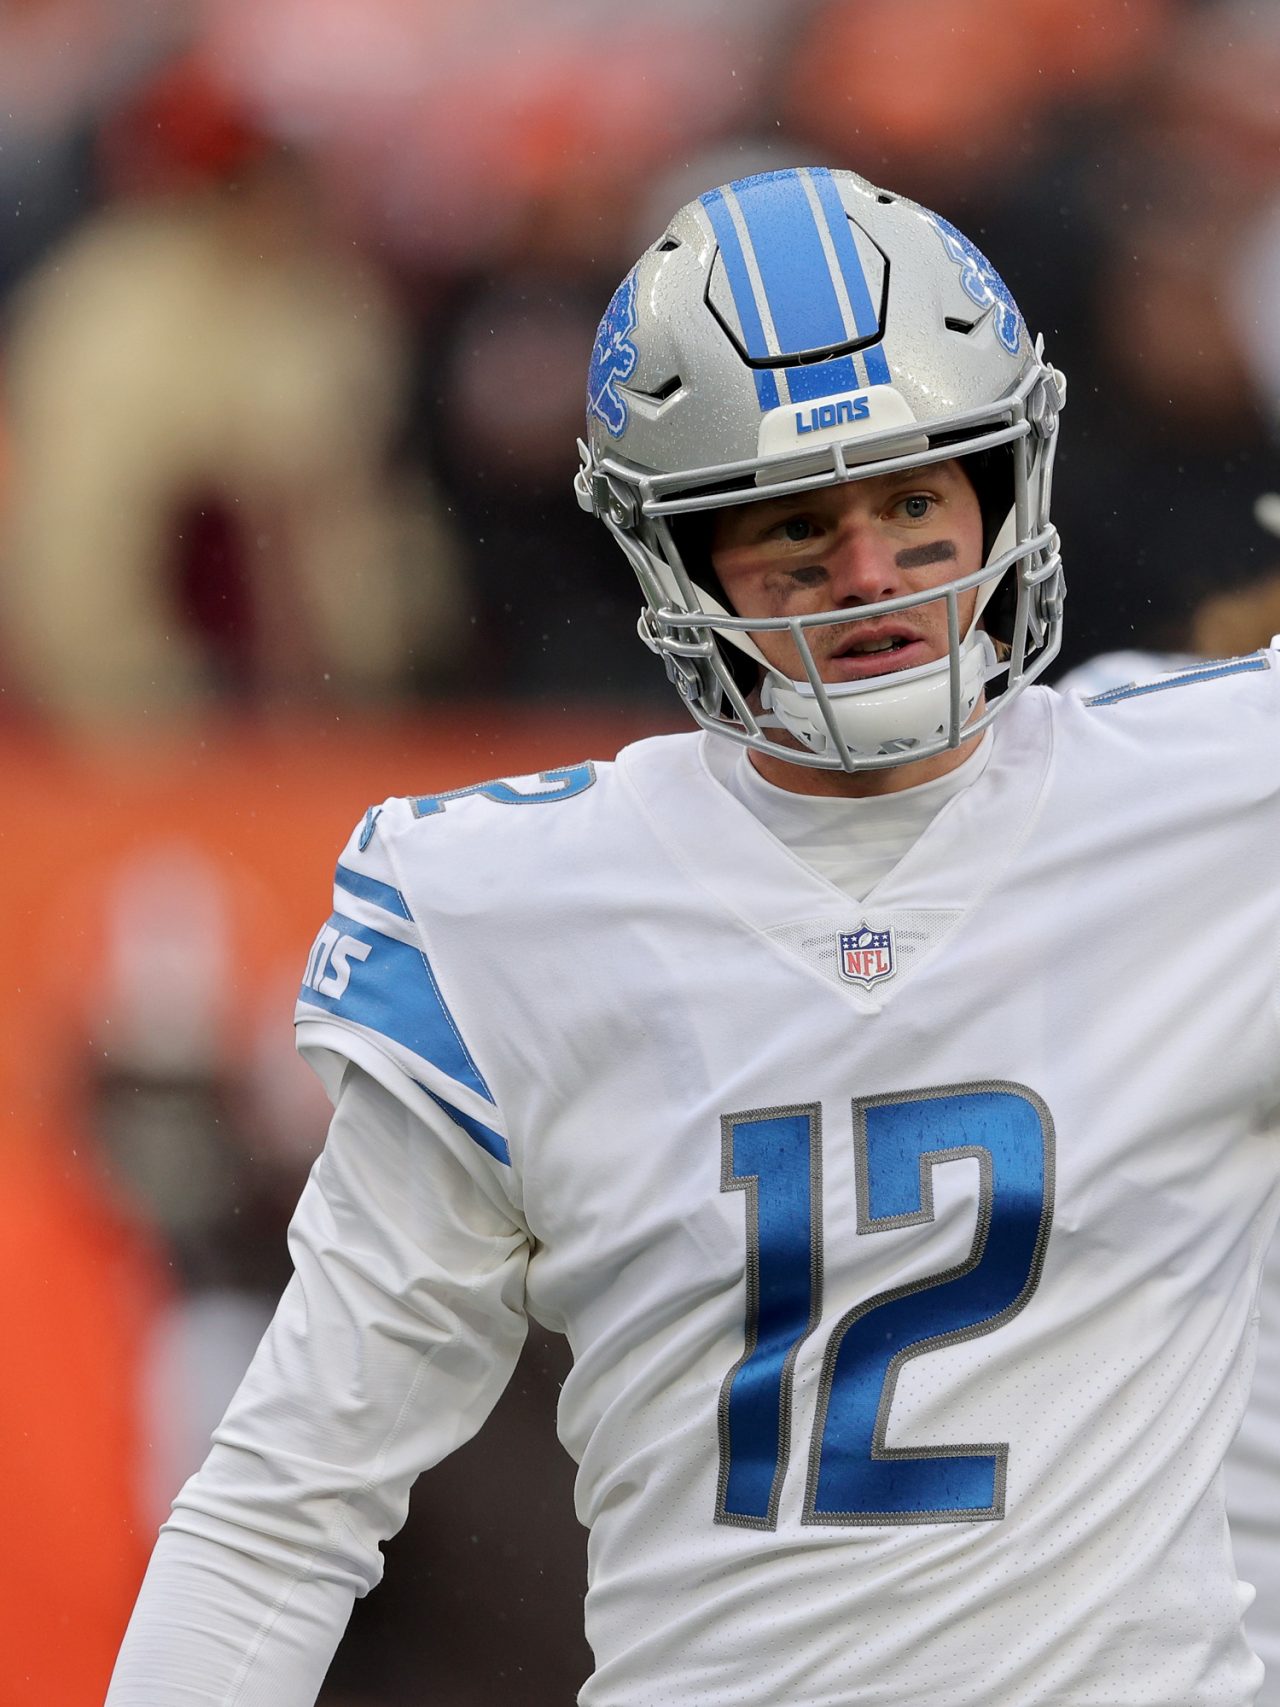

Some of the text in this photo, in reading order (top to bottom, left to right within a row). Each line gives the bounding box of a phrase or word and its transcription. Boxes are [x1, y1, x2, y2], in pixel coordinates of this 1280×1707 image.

[795, 396, 870, 434] LIONS
[846, 950, 888, 976] NFL
[713, 1079, 1056, 1532] 12
